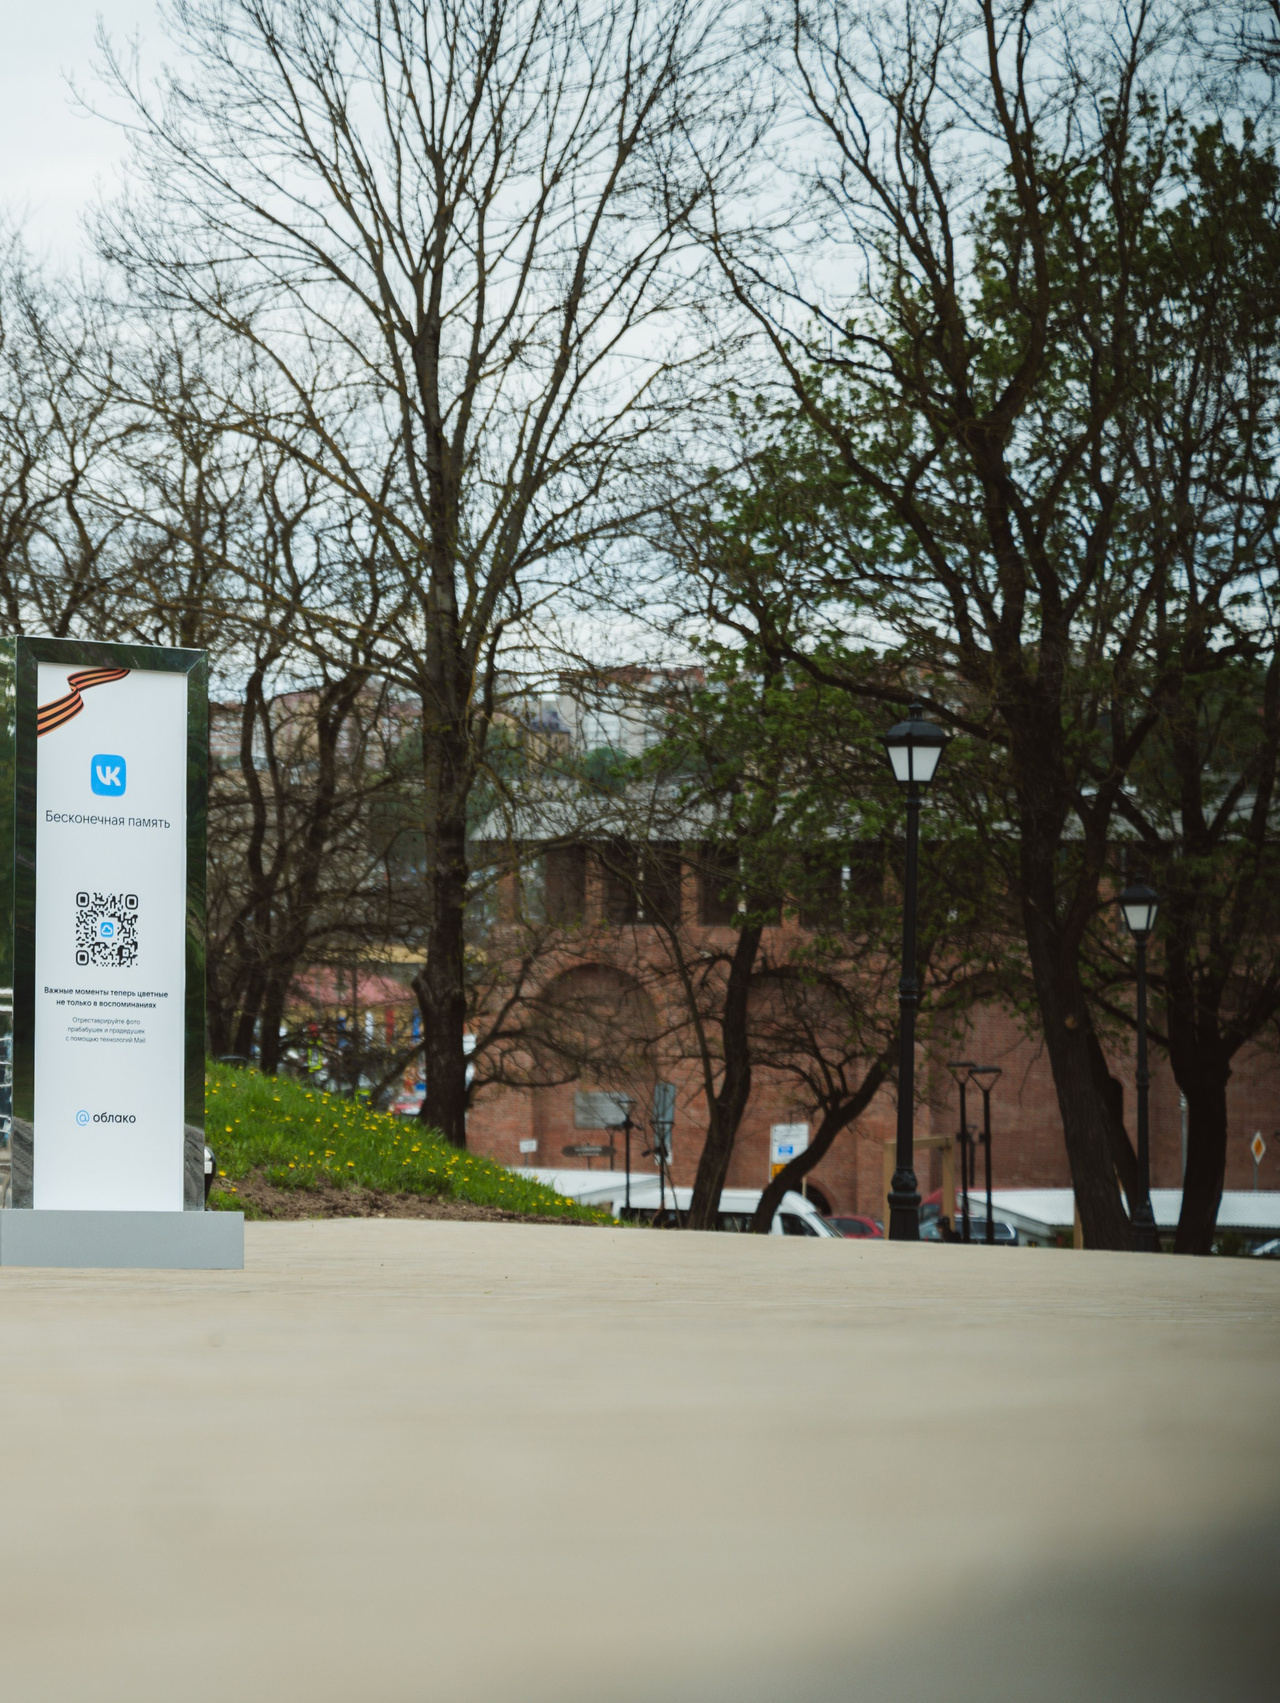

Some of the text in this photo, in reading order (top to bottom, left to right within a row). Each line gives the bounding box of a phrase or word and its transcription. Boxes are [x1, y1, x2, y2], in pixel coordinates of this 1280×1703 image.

[96, 765, 121, 786] VK
[45, 810, 171, 829] Бесконечная память
[44, 987, 169, 999] Важные моменты теперь цветные
[99, 1000, 157, 1009] воспоминаниях
[125, 1018, 141, 1026] фото
[67, 1026, 103, 1034] прабабушек
[109, 1027, 145, 1035] прадедушек
[99, 1036, 133, 1044] технологий
[93, 1112, 136, 1123] облако
